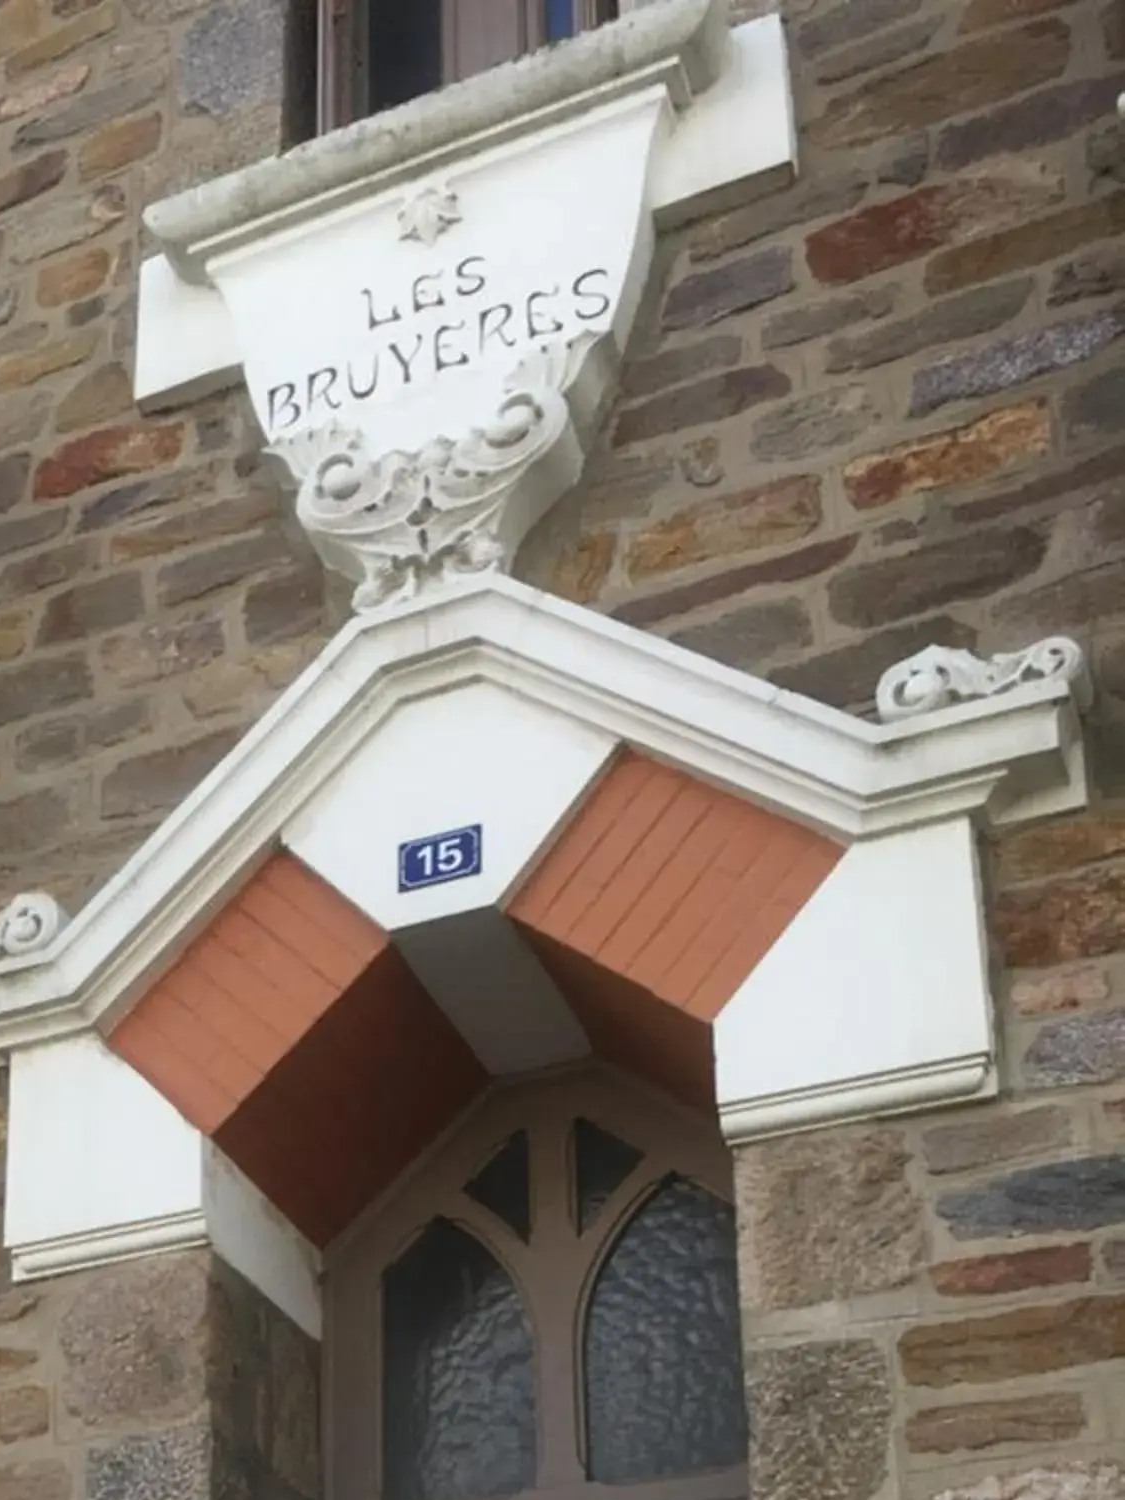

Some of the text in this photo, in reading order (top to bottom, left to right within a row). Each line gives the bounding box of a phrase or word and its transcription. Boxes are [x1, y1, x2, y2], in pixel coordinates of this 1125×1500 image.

[361, 255, 486, 329] LES
[267, 269, 611, 428] BRUYERES
[416, 838, 463, 876] 15
